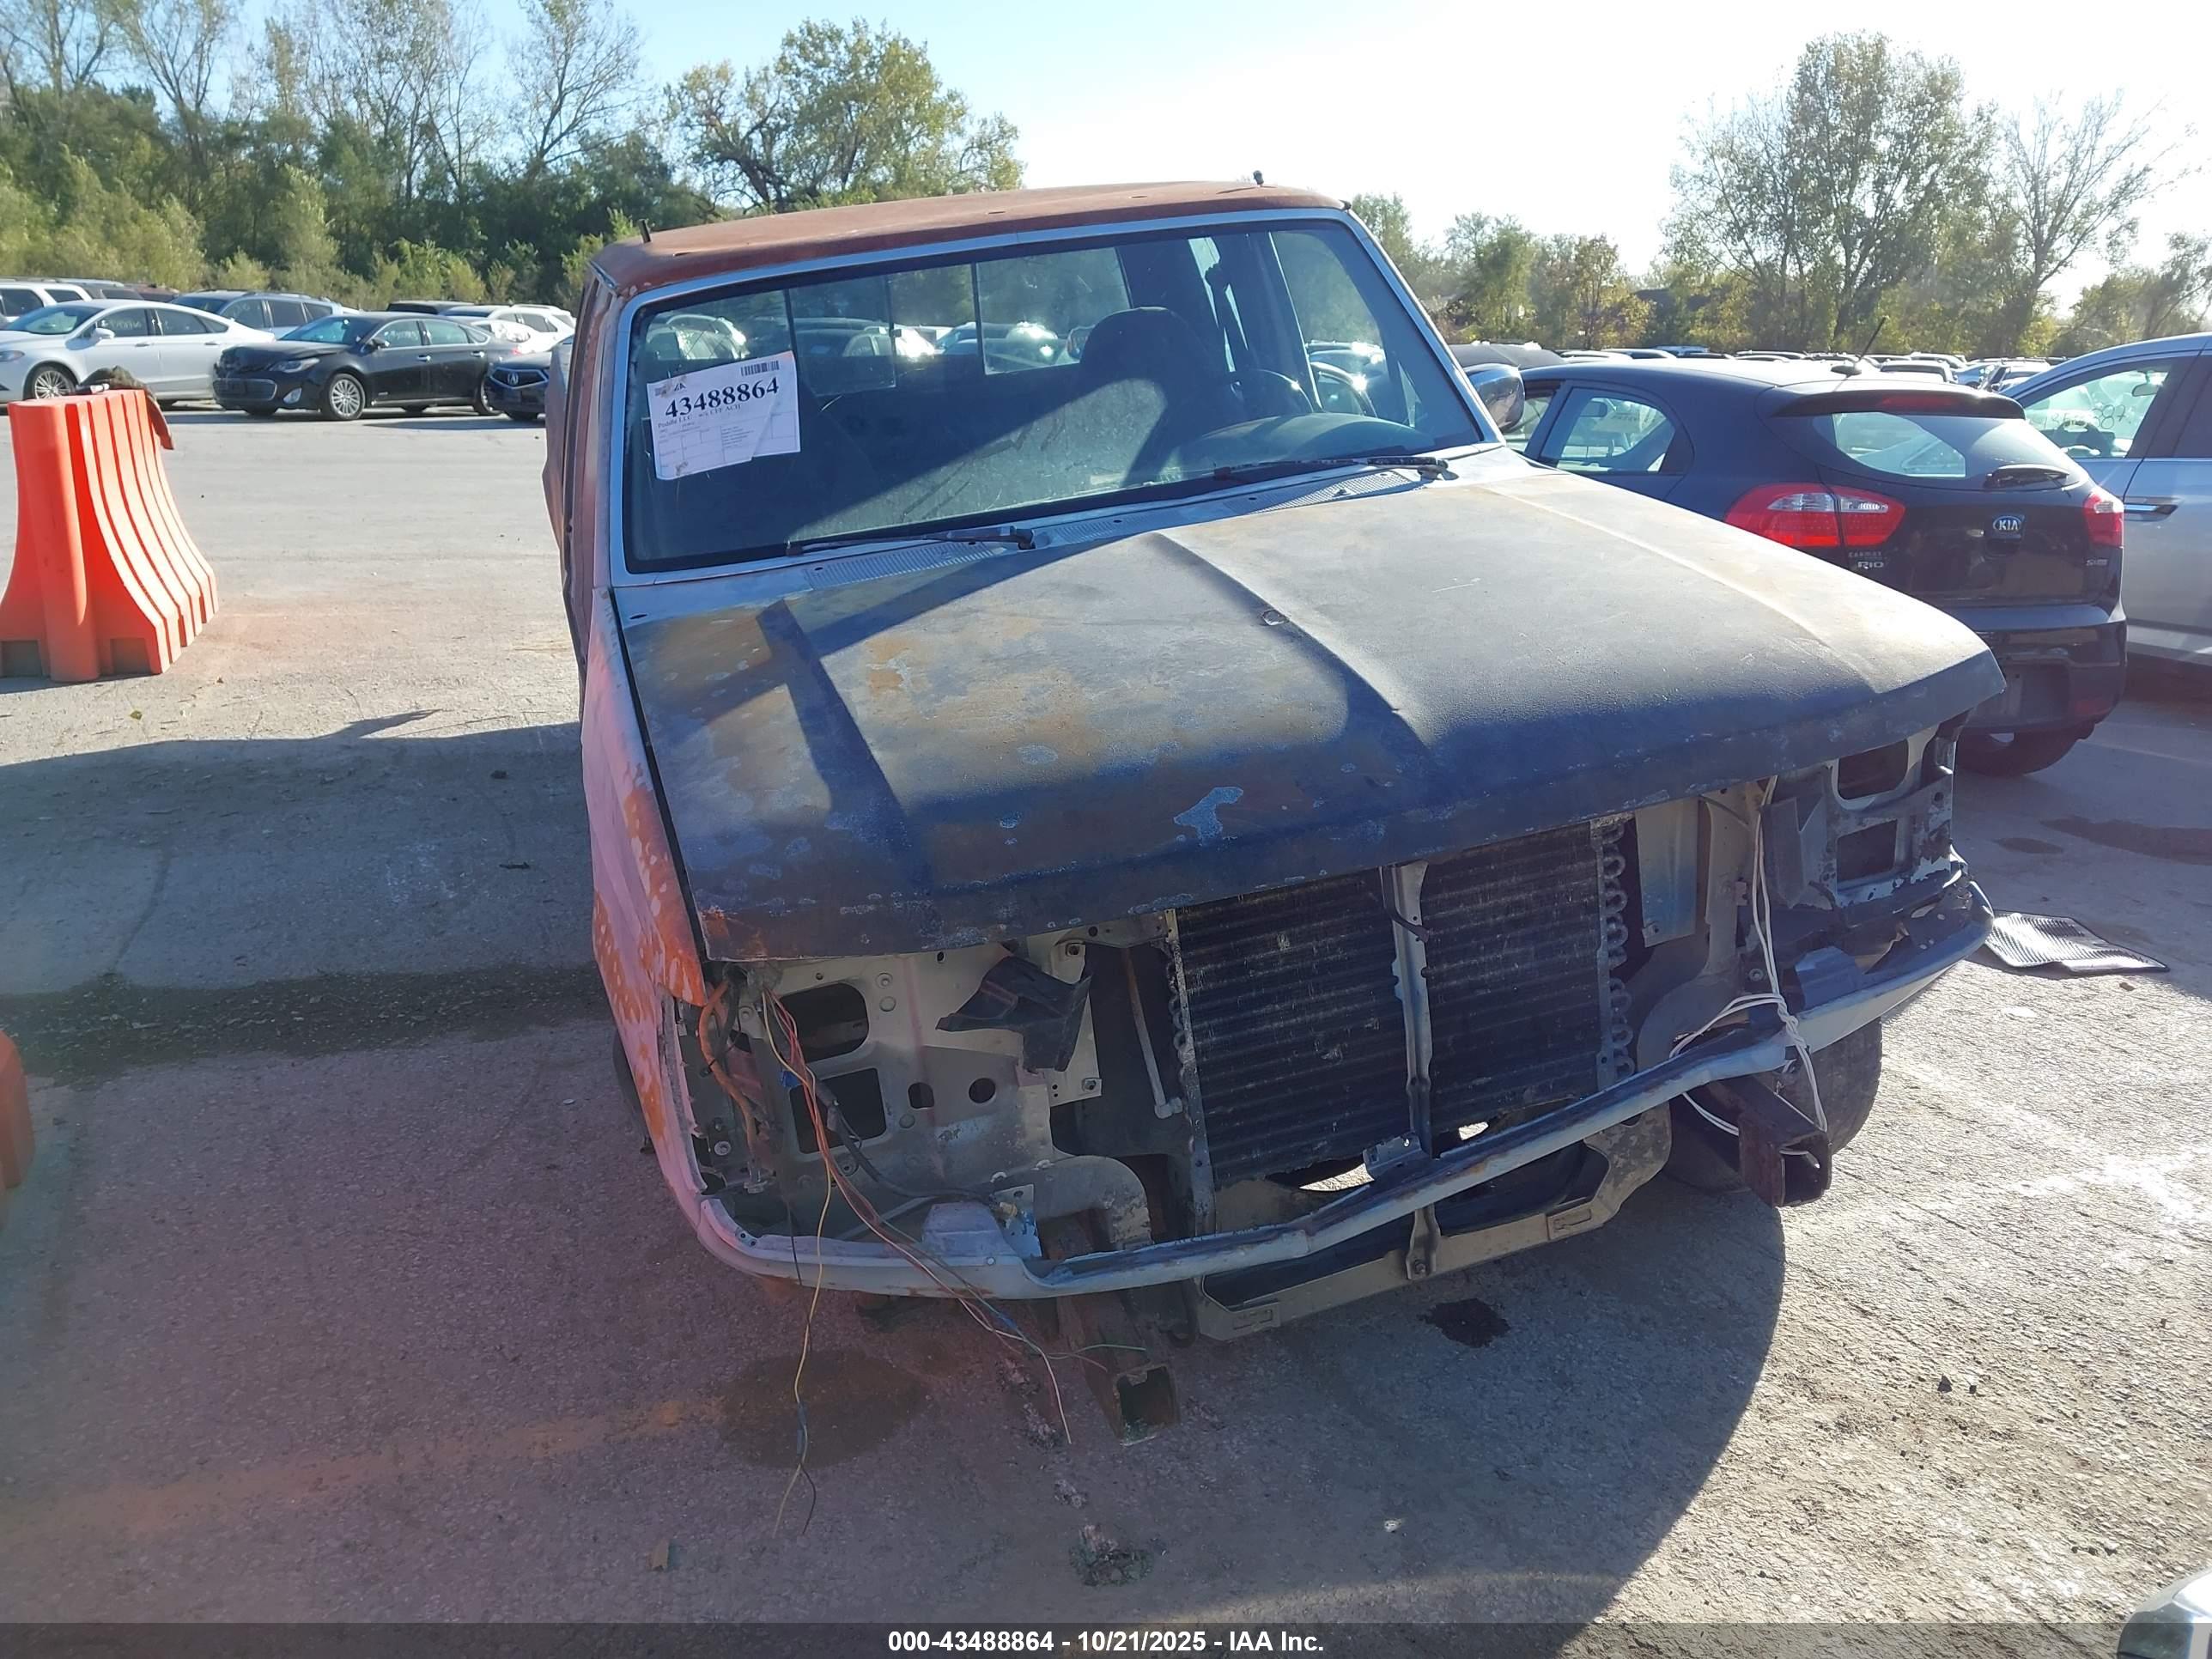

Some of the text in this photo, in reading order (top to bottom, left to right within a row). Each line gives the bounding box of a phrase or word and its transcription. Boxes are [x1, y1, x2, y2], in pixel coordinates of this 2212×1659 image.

[665, 376, 780, 418] 43488864
[1998, 519, 2019, 532] KIA
[1857, 561, 1884, 569] RIO
